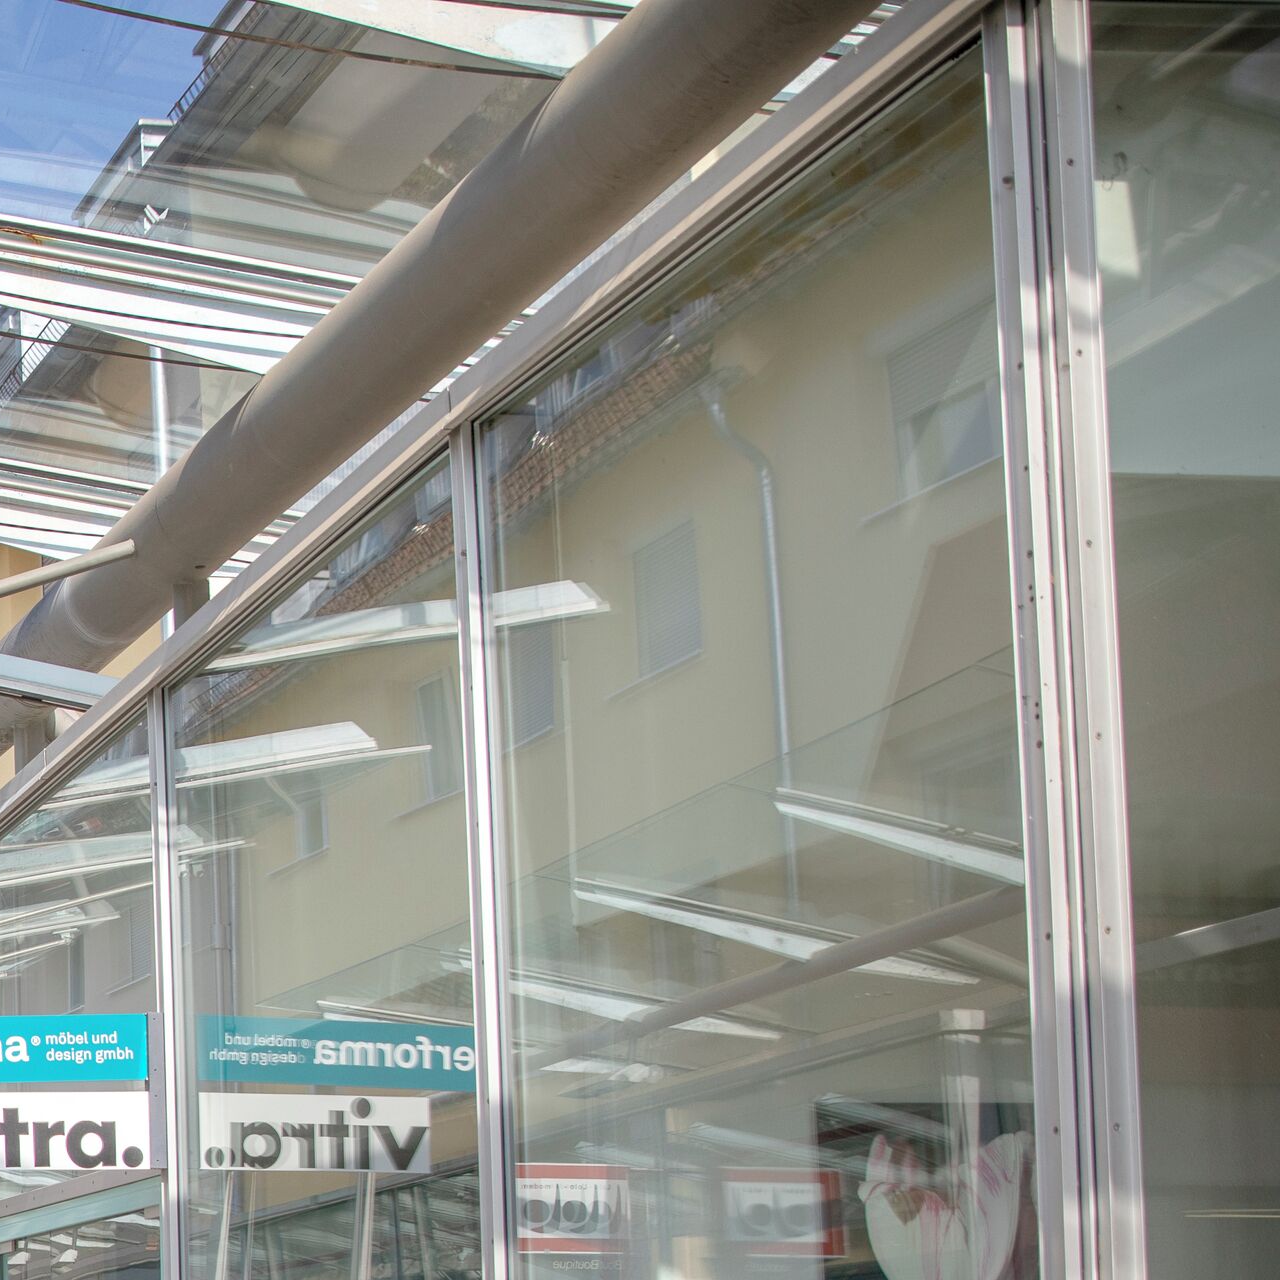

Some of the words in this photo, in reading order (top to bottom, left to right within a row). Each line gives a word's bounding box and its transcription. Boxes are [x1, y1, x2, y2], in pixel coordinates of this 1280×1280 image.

[45, 1031, 89, 1045] möbel
[91, 1031, 118, 1045] und
[45, 1047, 92, 1064] design
[95, 1047, 134, 1064] gmbh
